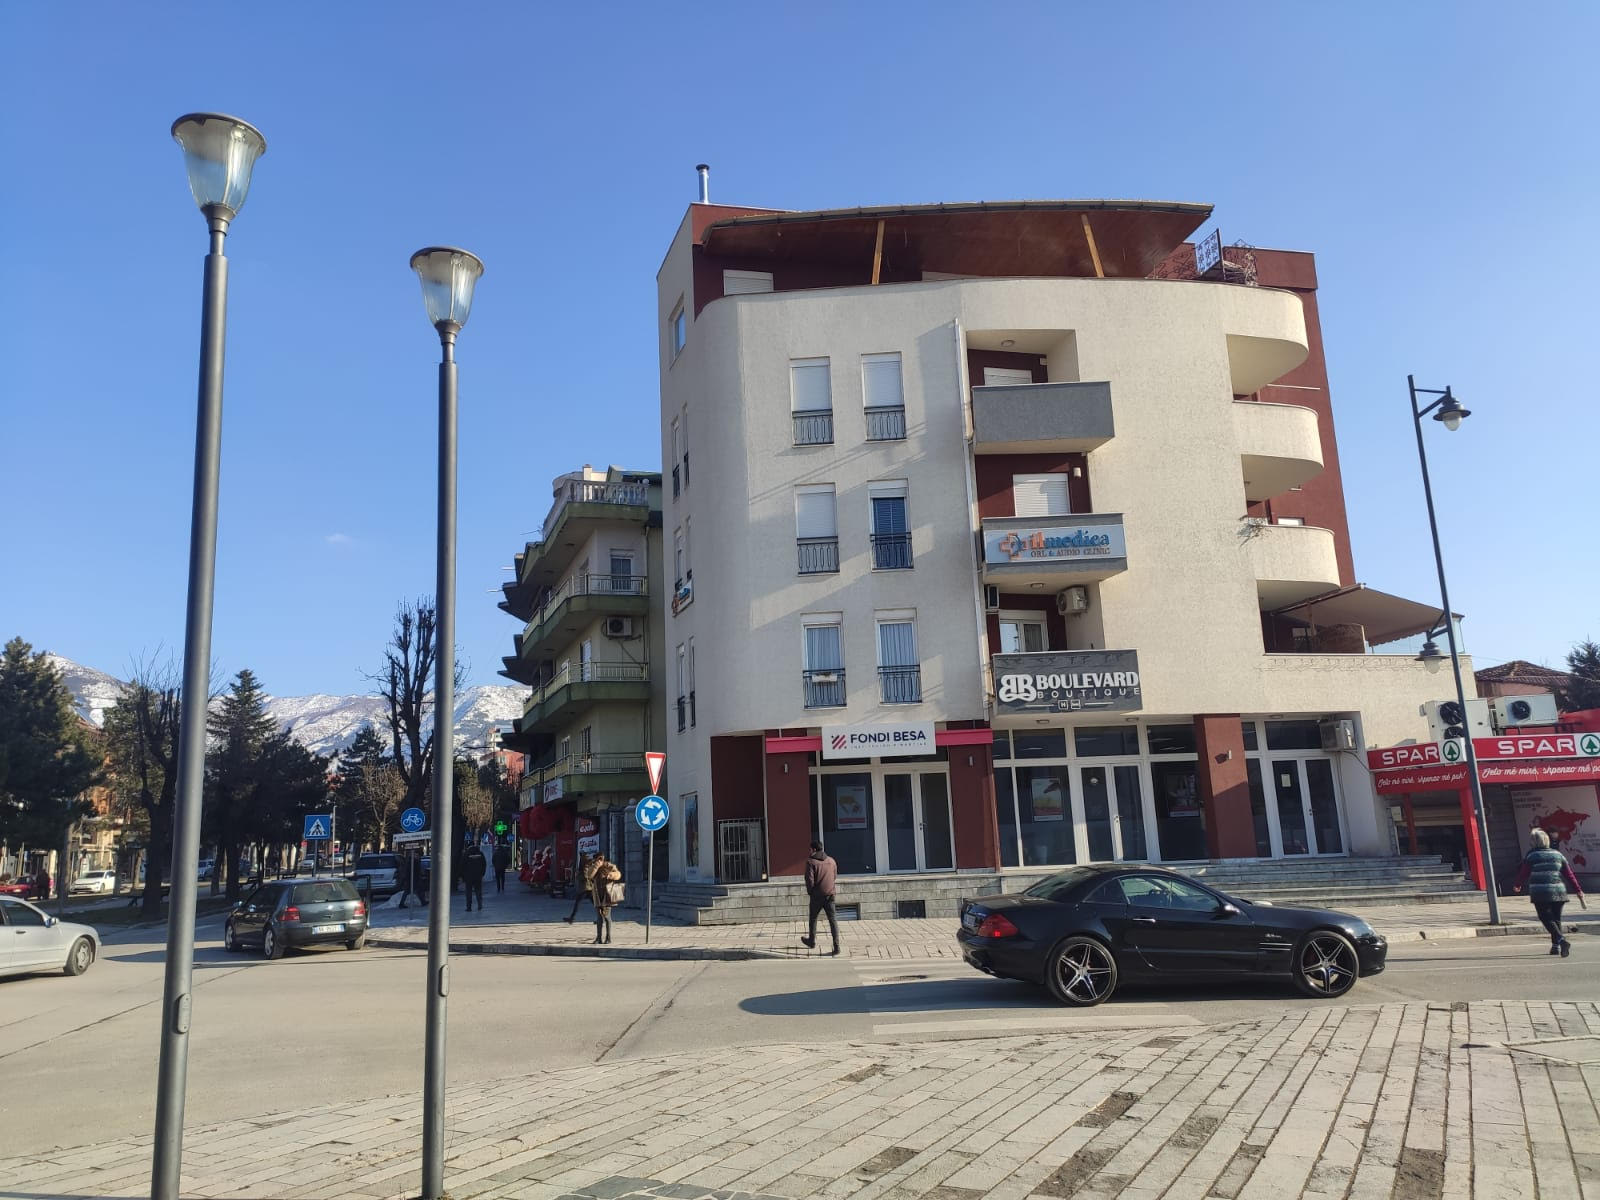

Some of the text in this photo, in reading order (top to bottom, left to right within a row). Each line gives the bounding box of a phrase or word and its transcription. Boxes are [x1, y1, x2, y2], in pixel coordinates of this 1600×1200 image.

[1030, 550, 1047, 558] ORL
[1056, 548, 1081, 557] AUDIO
[1083, 547, 1111, 556] CLINIC
[1036, 672, 1139, 690] BOULEVARD
[1037, 687, 1140, 699] BOUTIQUE
[850, 730, 926, 744] FONDI BESA
[1497, 738, 1575, 755] SPAR
[1382, 746, 1439, 765] SPAR
